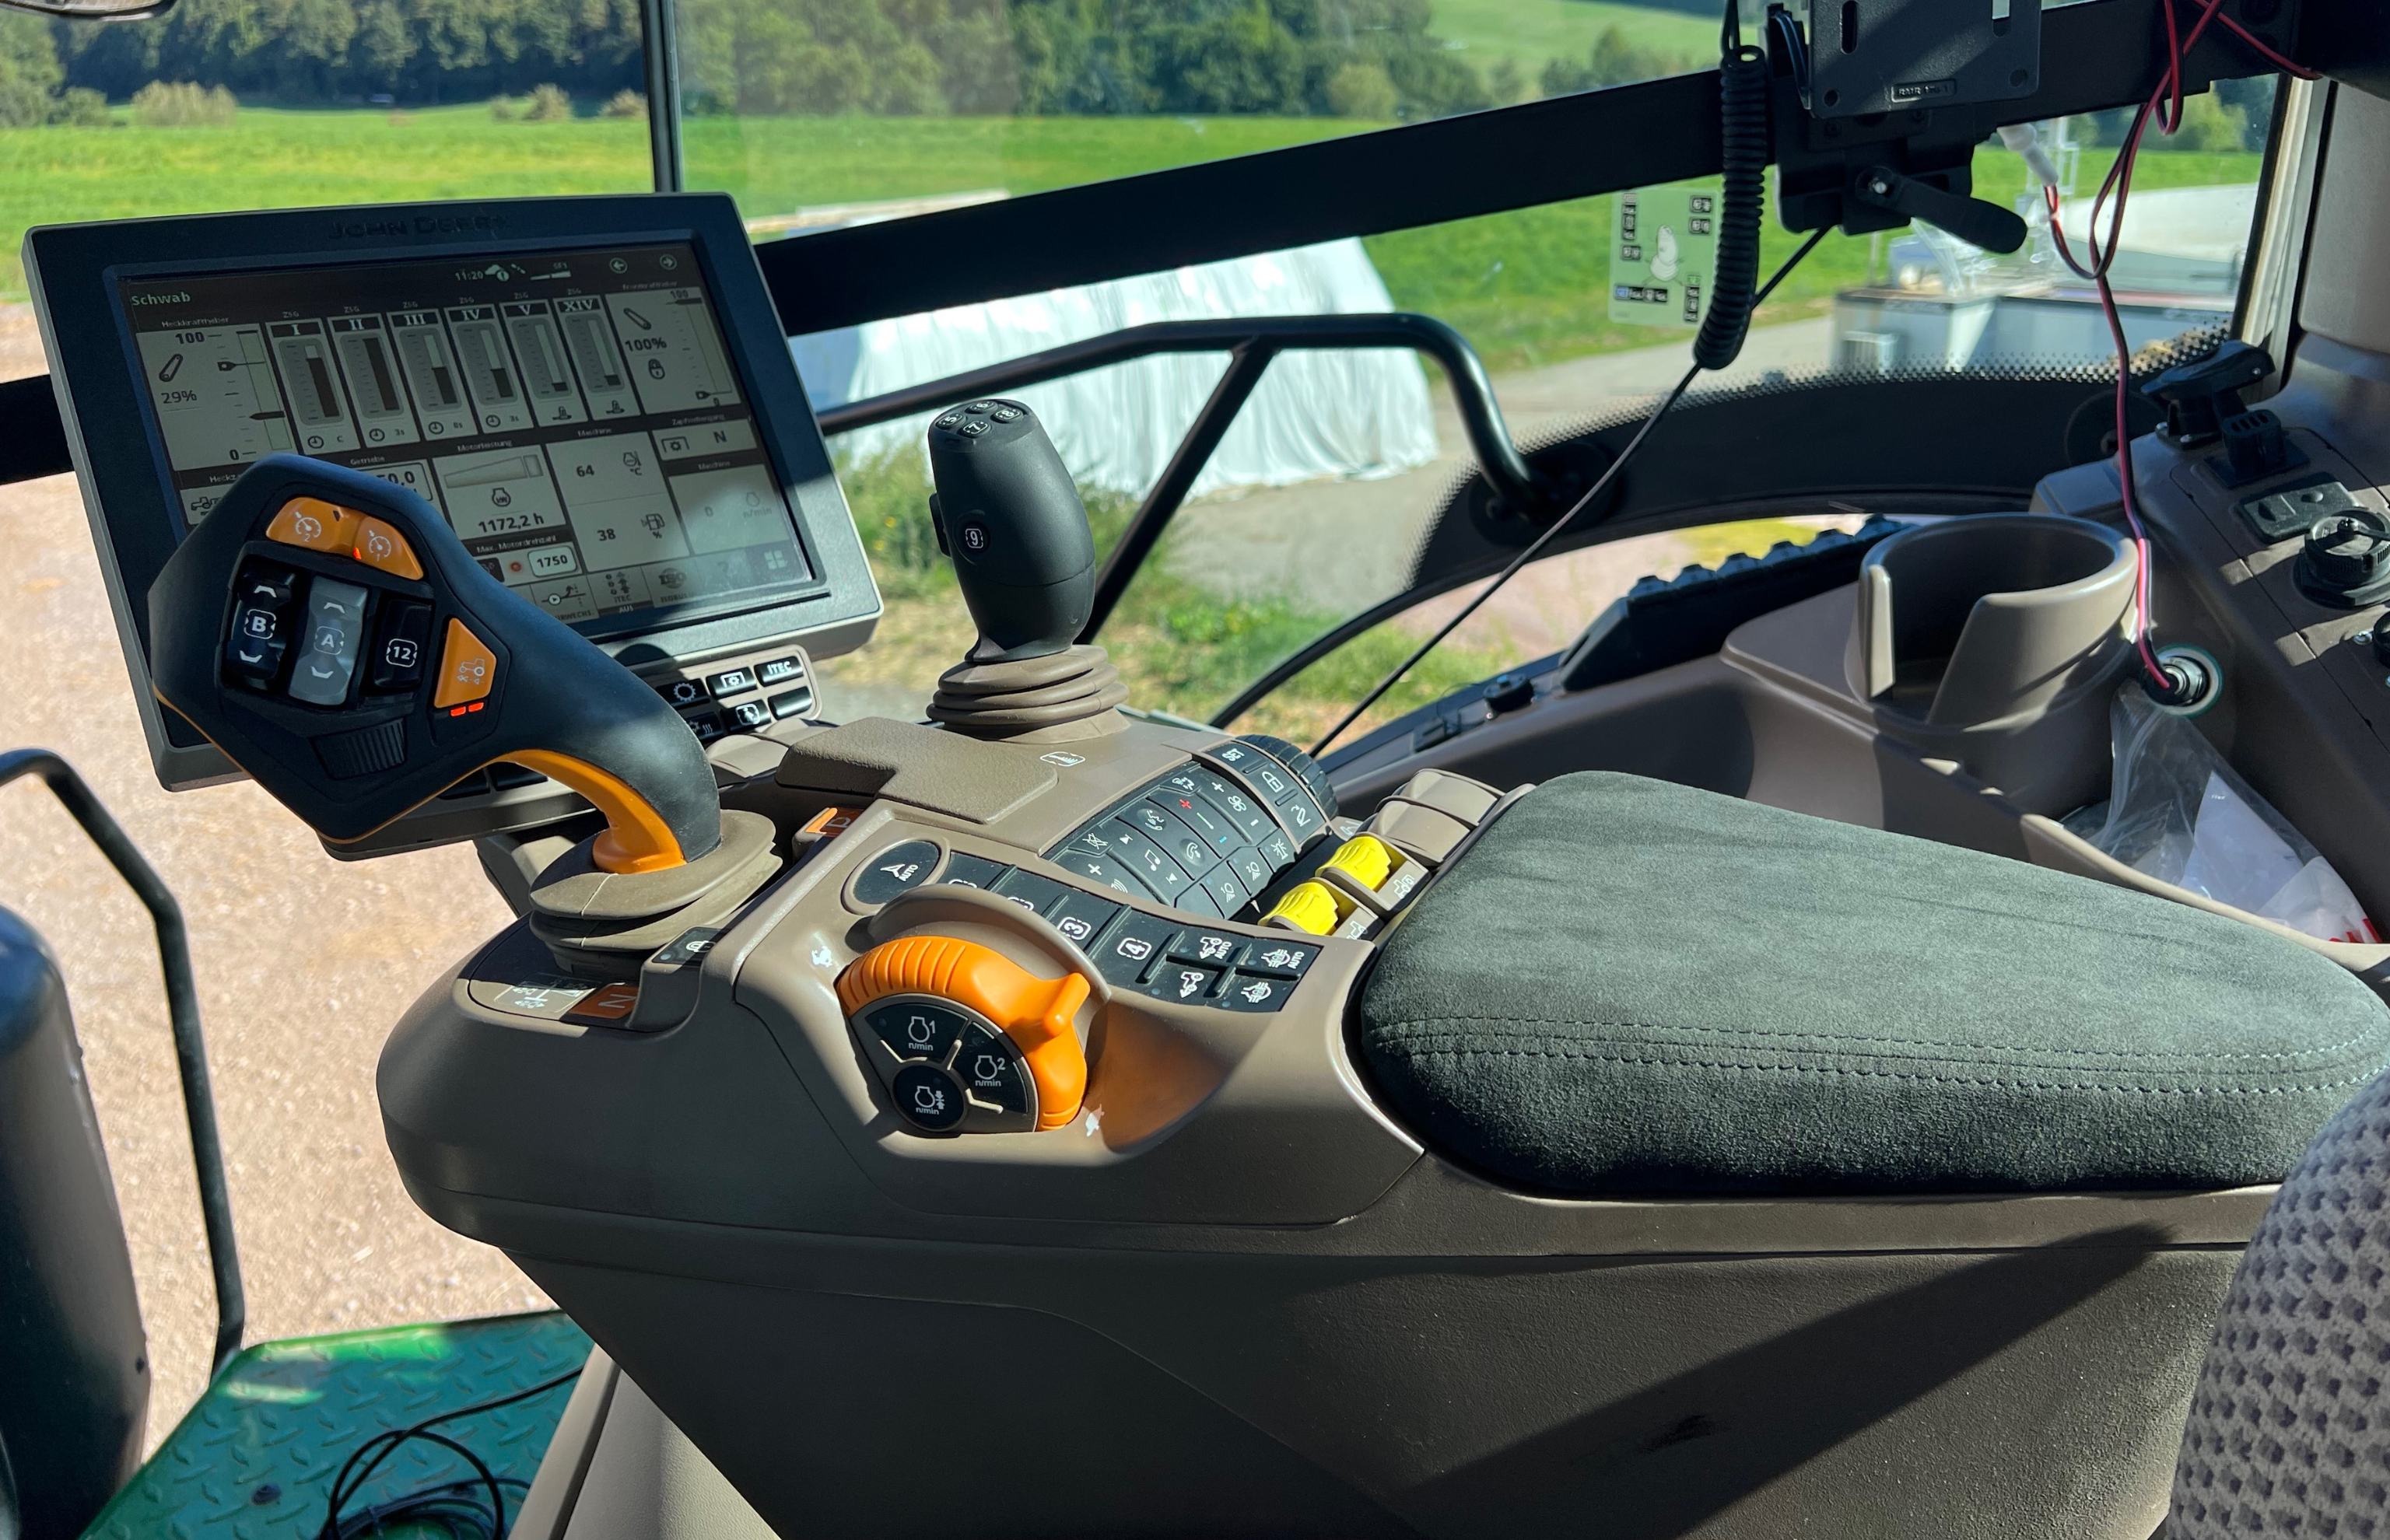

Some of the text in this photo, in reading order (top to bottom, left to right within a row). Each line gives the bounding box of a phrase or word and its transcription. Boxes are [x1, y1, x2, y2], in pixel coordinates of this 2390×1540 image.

[329, 220, 408, 239] JOHN
[454, 270, 484, 282] 11:20
[131, 291, 191, 306] Schwab
[670, 289, 689, 299] 100
[518, 304, 532, 316] V
[563, 299, 594, 313] XIV
[404, 313, 426, 326] III
[462, 309, 481, 321] IV
[291, 324, 301, 336] I
[349, 319, 365, 331] II
[175, 331, 205, 345] 100
[625, 336, 668, 352] 100%
[160, 390, 198, 404] 29%
[969, 422, 981, 431] 7
[712, 430, 728, 443] N
[229, 449, 240, 460] 0
[209, 473, 238, 483] Heckz
[576, 464, 595, 478] 64
[376, 471, 415, 487] 0,0
[743, 506, 773, 519] n/min
[478, 513, 545, 533] 1172,2 h
[303, 534, 311, 543] 2
[597, 527, 617, 542] 38
[969, 531, 979, 546] 9
[537, 554, 568, 569] 1750
[251, 618, 267, 633] B
[321, 633, 335, 648] A
[392, 646, 412, 660] 12
[1221, 747, 1246, 761] SET
[898, 863, 919, 882] AUTO
[1064, 922, 1084, 935] 3
[1129, 942, 1144, 956] 4
[1213, 940, 1232, 960] AUTO
[1289, 950, 1305, 970] AUTO
[929, 1021, 935, 1034] 1
[908, 1041, 934, 1052] n/min
[997, 1057, 1006, 1070] 2
[975, 1077, 1001, 1087] n/min
[915, 1105, 940, 1115] n/min
